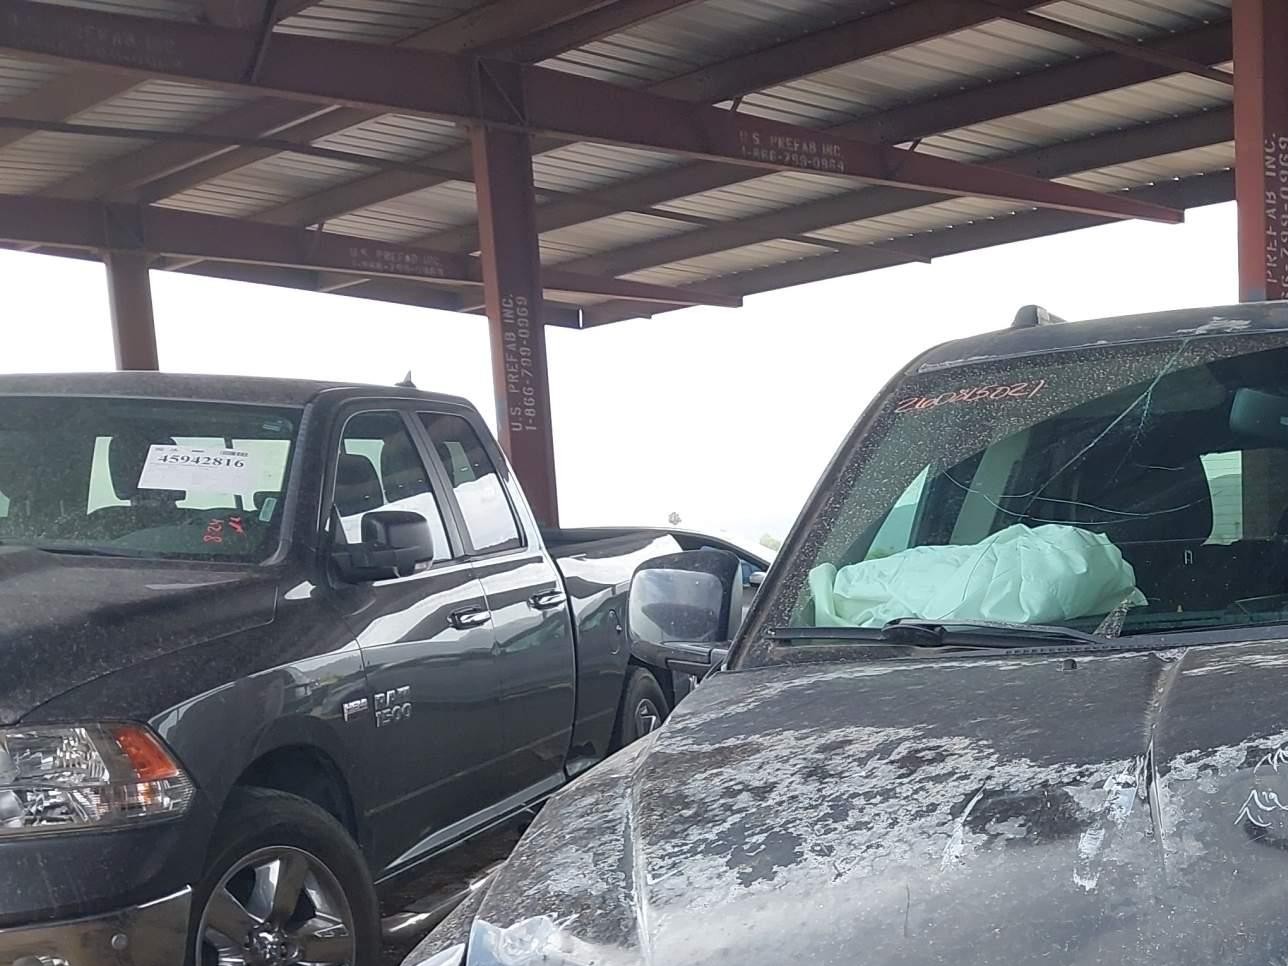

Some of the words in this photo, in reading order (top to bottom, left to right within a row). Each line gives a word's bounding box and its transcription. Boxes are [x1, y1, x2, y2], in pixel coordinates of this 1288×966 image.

[1264, 132, 1277, 177] INC.
[1264, 191, 1278, 283] PREFAB
[502, 294, 515, 323] INC.
[505, 331, 520, 393] PREFAB
[157, 454, 245, 468] 45942816
